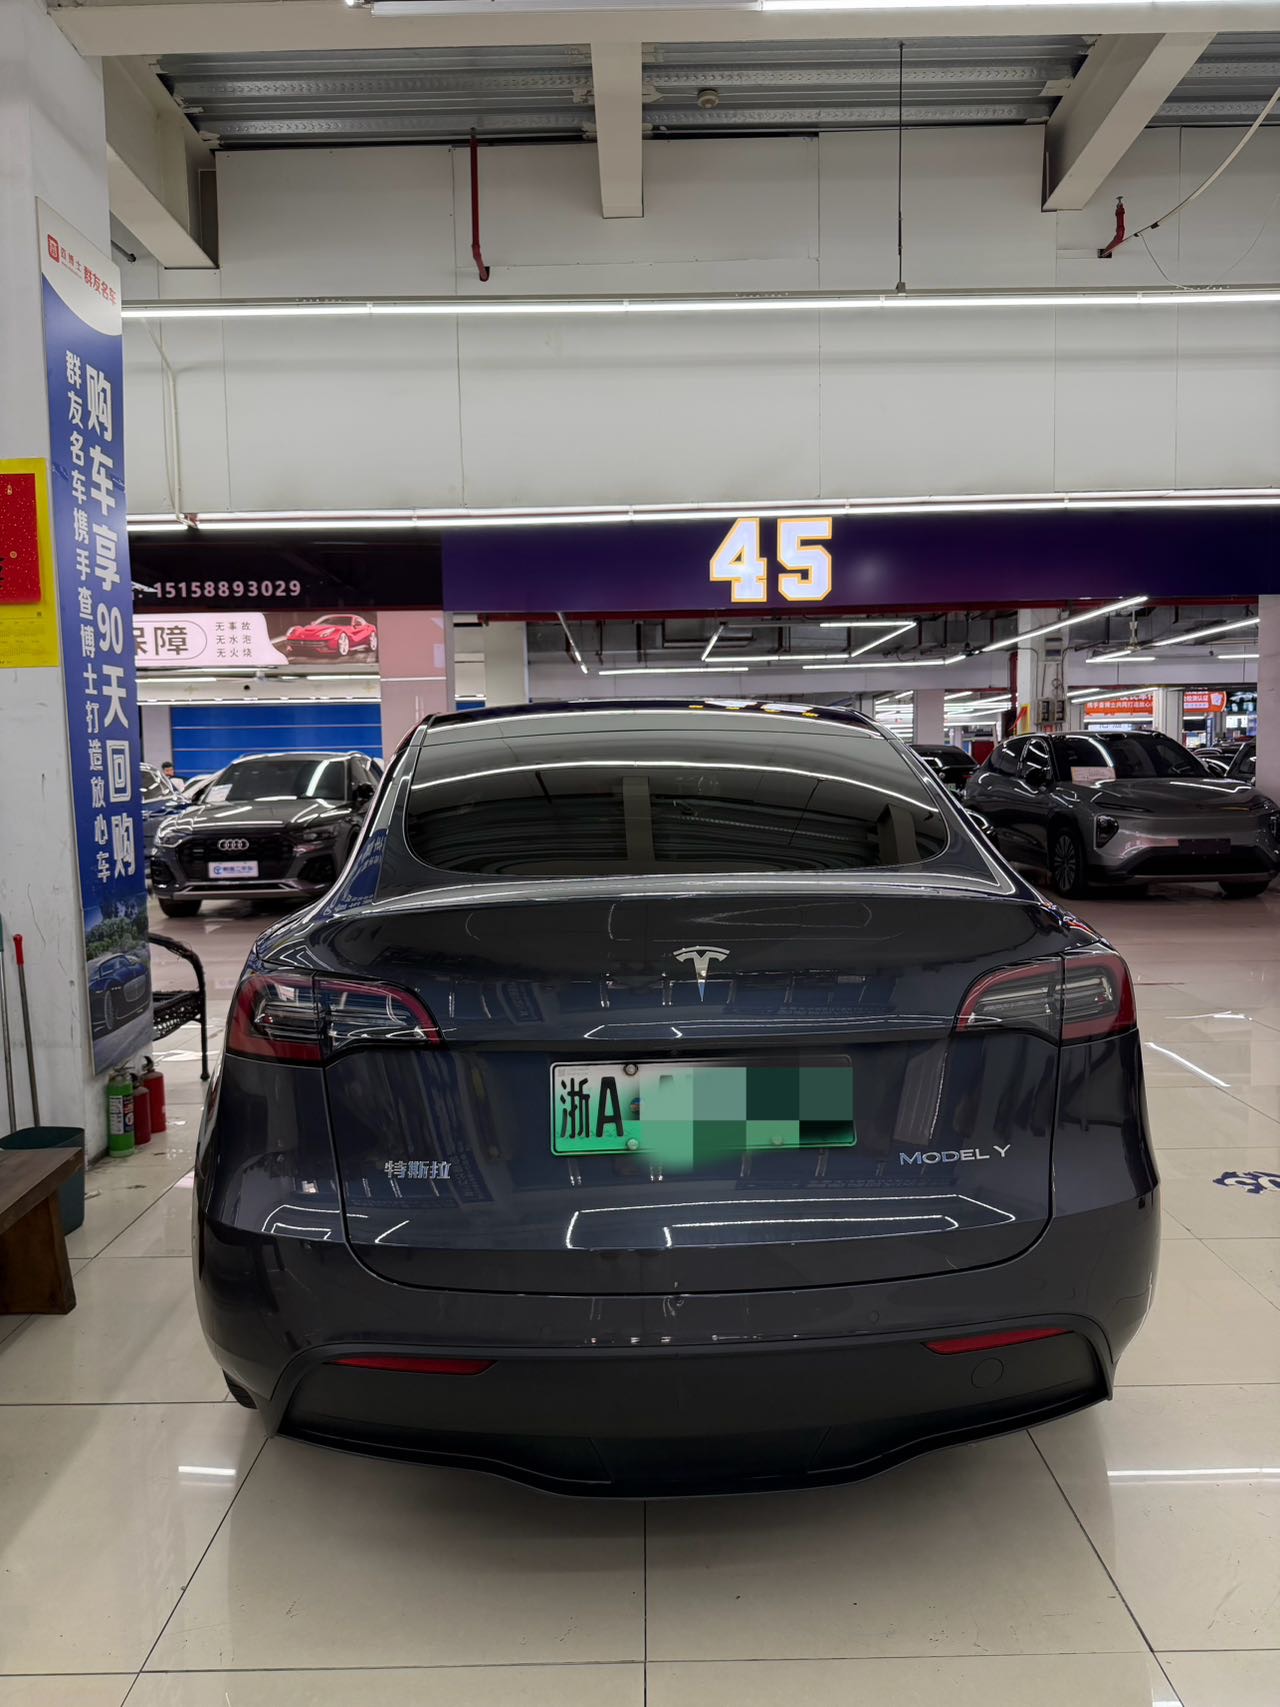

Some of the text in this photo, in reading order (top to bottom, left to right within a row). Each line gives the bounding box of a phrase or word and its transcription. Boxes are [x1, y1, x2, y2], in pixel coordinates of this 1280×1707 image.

[709, 517, 833, 602] 45
[154, 580, 301, 599] 15158893029
[65, 350, 111, 884] 群友名车携手查博士打造放心车
[86, 364, 136, 879] 购车享90天回购
[215, 621, 252, 632] 无事故
[216, 634, 252, 646] 无水泡
[899, 1144, 1011, 1165] MODEL Y
[384, 1160, 452, 1179] 特斯拉
